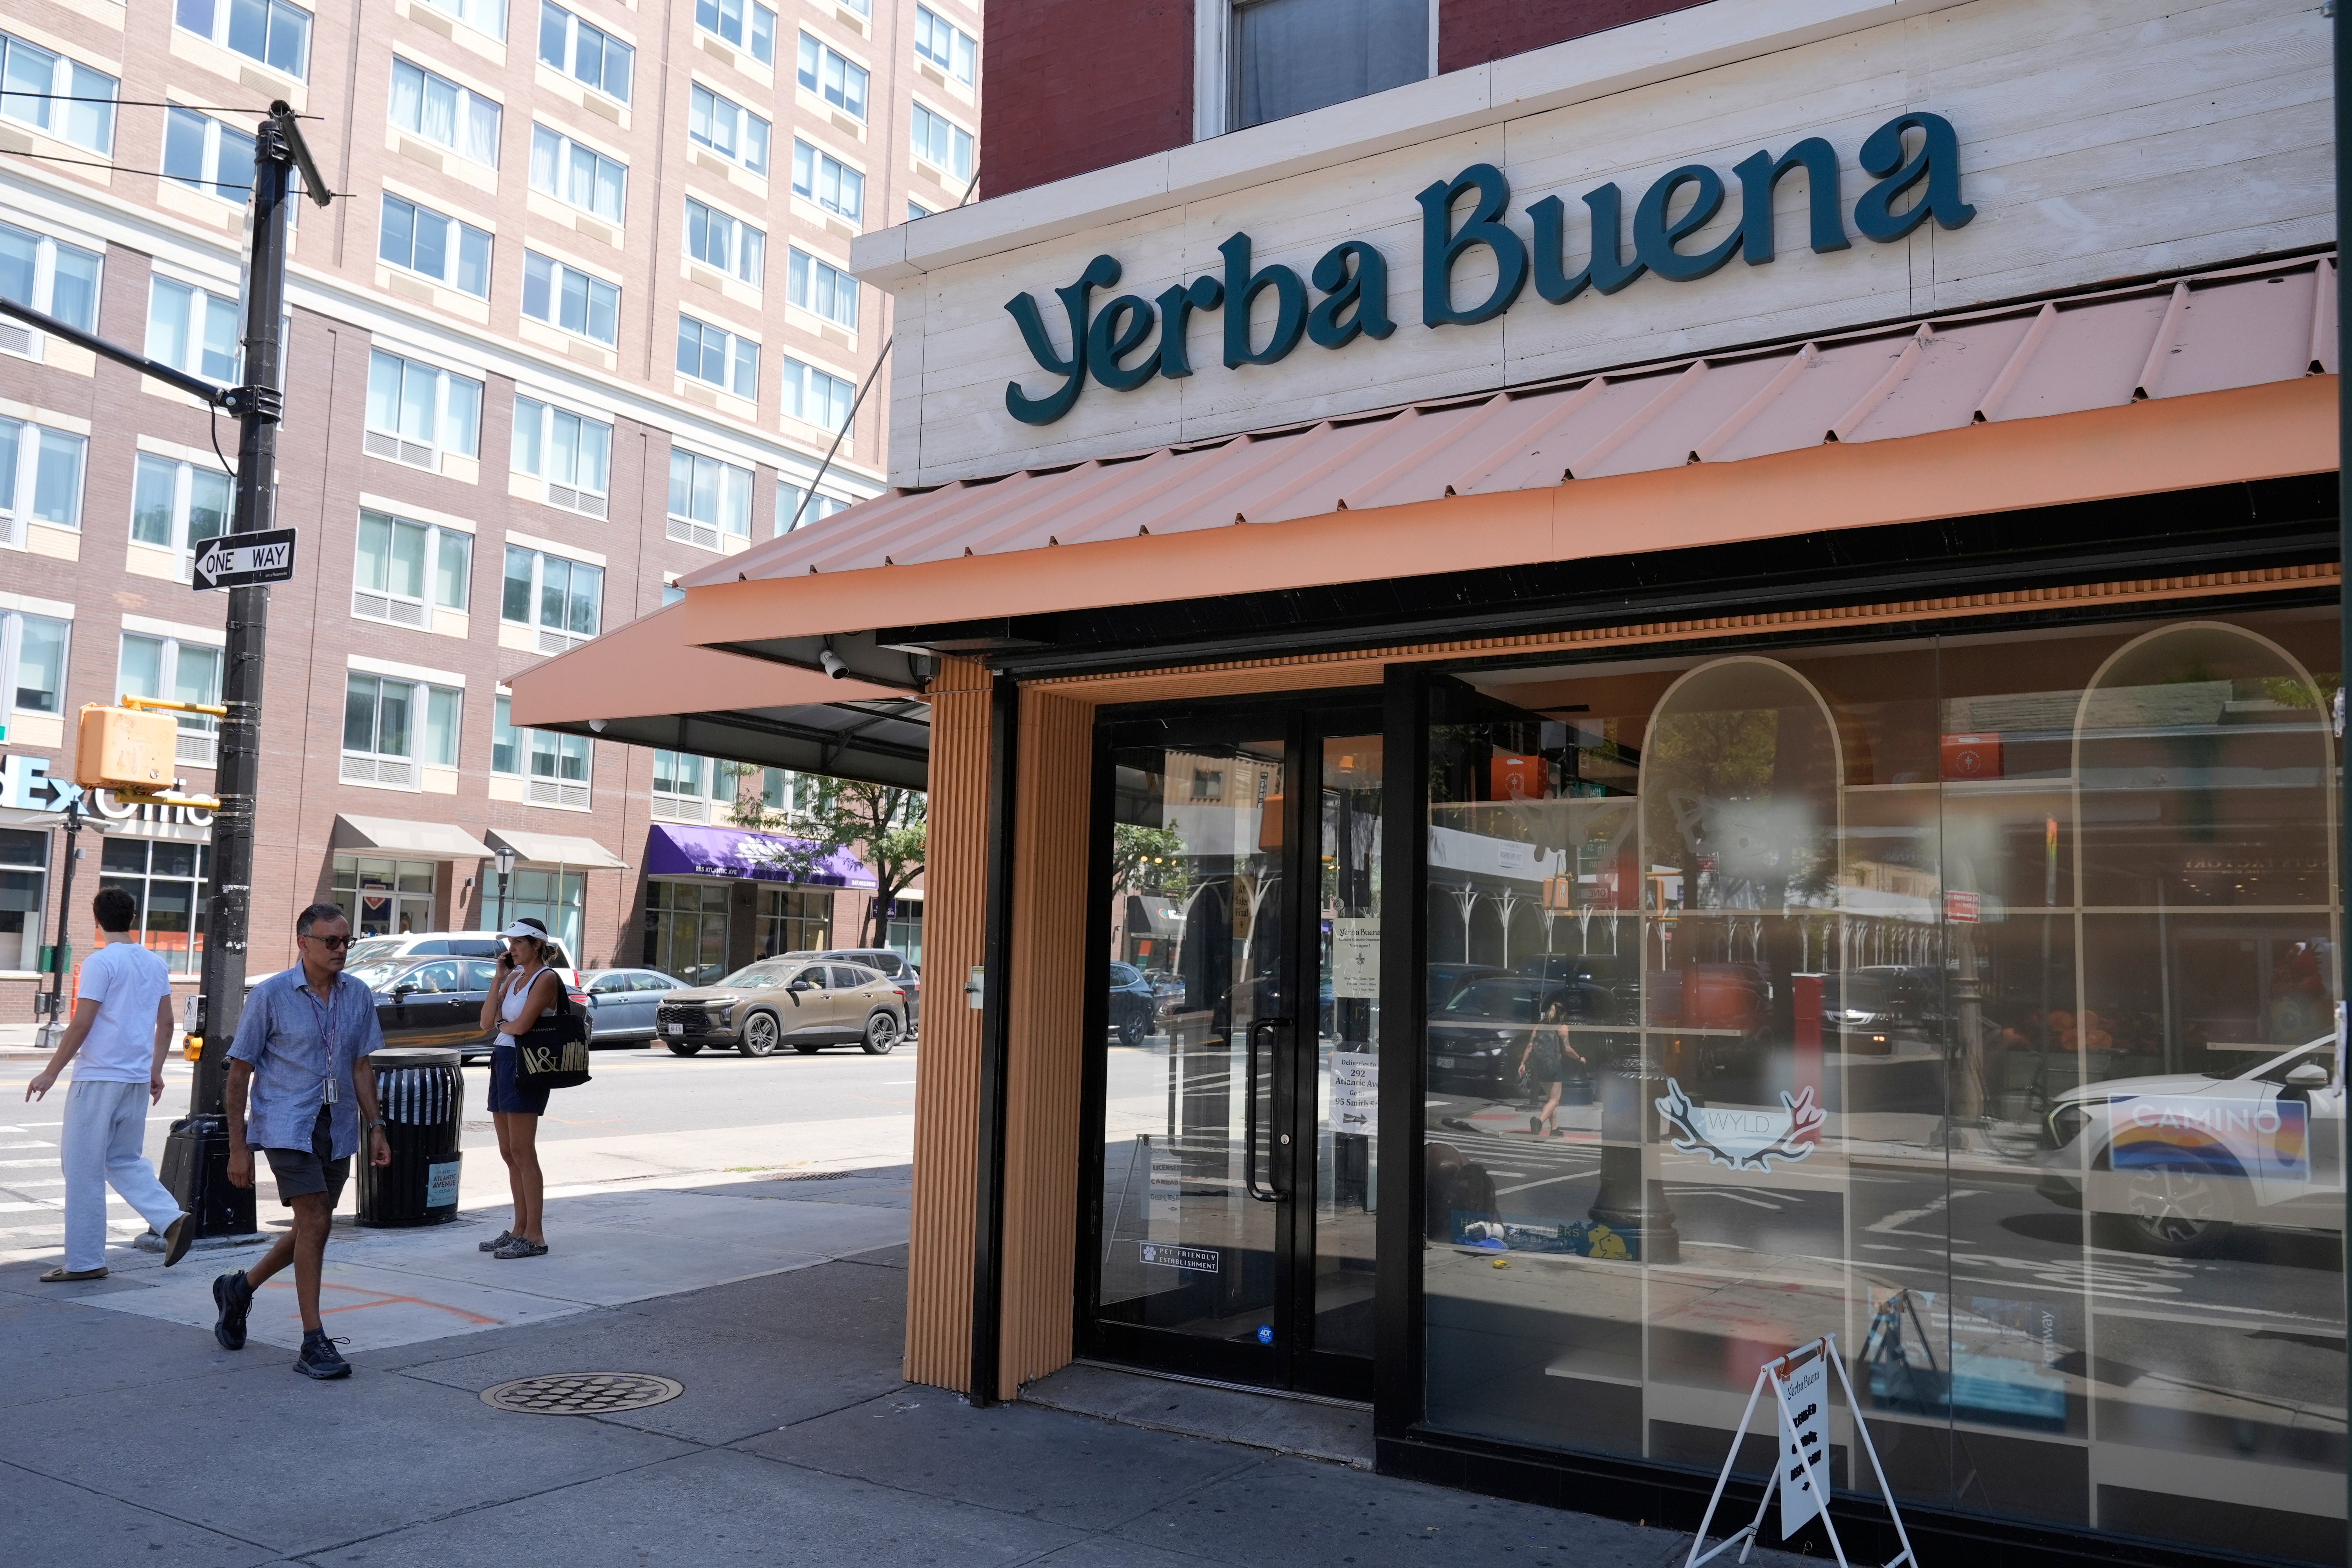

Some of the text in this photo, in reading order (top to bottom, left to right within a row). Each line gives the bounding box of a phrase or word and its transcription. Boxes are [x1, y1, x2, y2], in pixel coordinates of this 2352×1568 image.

[1004, 111, 1977, 427] Yerba Buena
[206, 545, 286, 573] ONE WAY
[1238, 885, 1247, 894] All
[1235, 896, 1249, 906] Sales
[1235, 908, 1249, 917] Final
[1339, 928, 1359, 936] Yerba
[1350, 1069, 1366, 1077] 292
[1335, 1077, 1366, 1086] Atlantic
[1346, 1099, 1368, 1108] Smith
[1708, 1112, 1769, 1133] WYLD
[2132, 1103, 2281, 1134] CAMINO
[433, 1174, 456, 1182] ATLANTIC
[432, 1180, 456, 1189] AVENUE
[1178, 1250, 1216, 1261] FRIENDLY
[1159, 1256, 1216, 1270] ESTABLISHMENT
[1788, 1370, 1820, 1401] Yerba Buena
